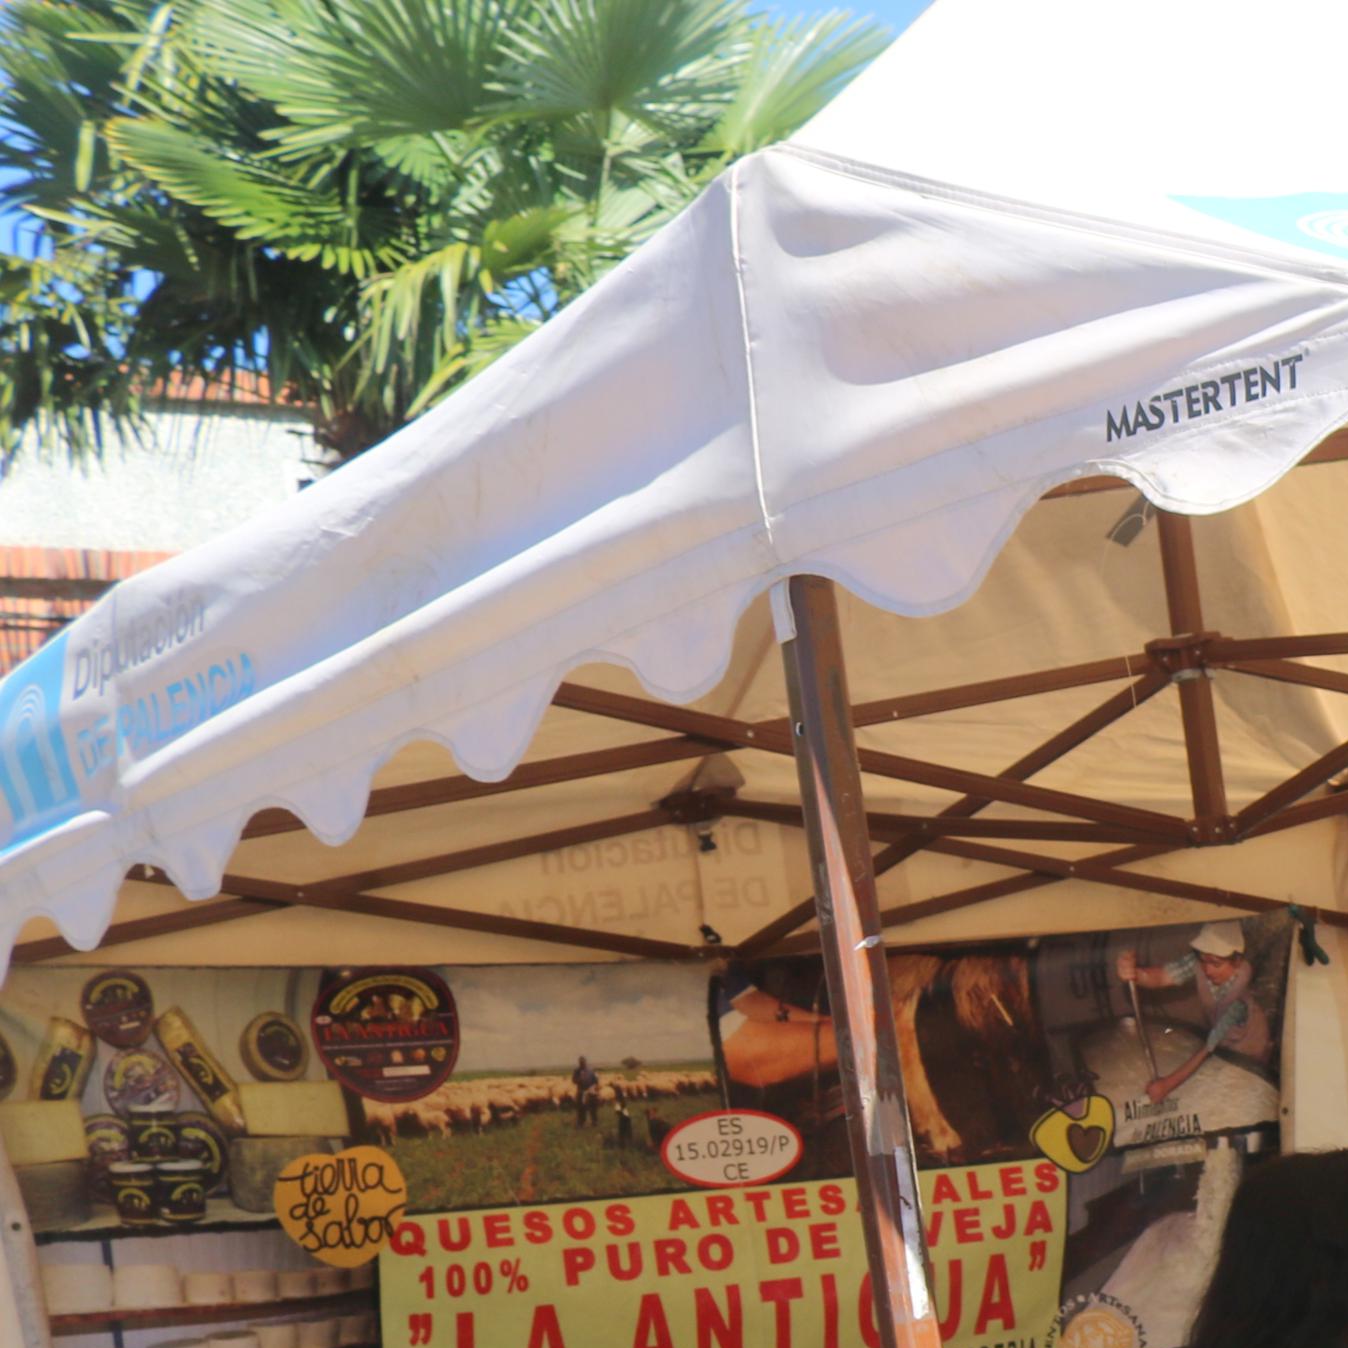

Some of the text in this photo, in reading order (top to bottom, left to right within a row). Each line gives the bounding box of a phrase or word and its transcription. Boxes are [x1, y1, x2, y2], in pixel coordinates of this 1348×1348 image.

[1105, 352, 1304, 443] MASTERTENT
[116, 652, 257, 757] PALENCIA
[675, 1135, 790, 1162] 15.02919/P
[716, 1116, 744, 1136] ES
[277, 1158, 403, 1197] tierra
[722, 1162, 750, 1181] CE
[289, 1196, 331, 1220] de
[299, 1193, 407, 1252] sabor
[388, 1161, 1062, 1258] QUESOS ARTESALES
[418, 1200, 1053, 1301] 100% PURO DE VEJA
